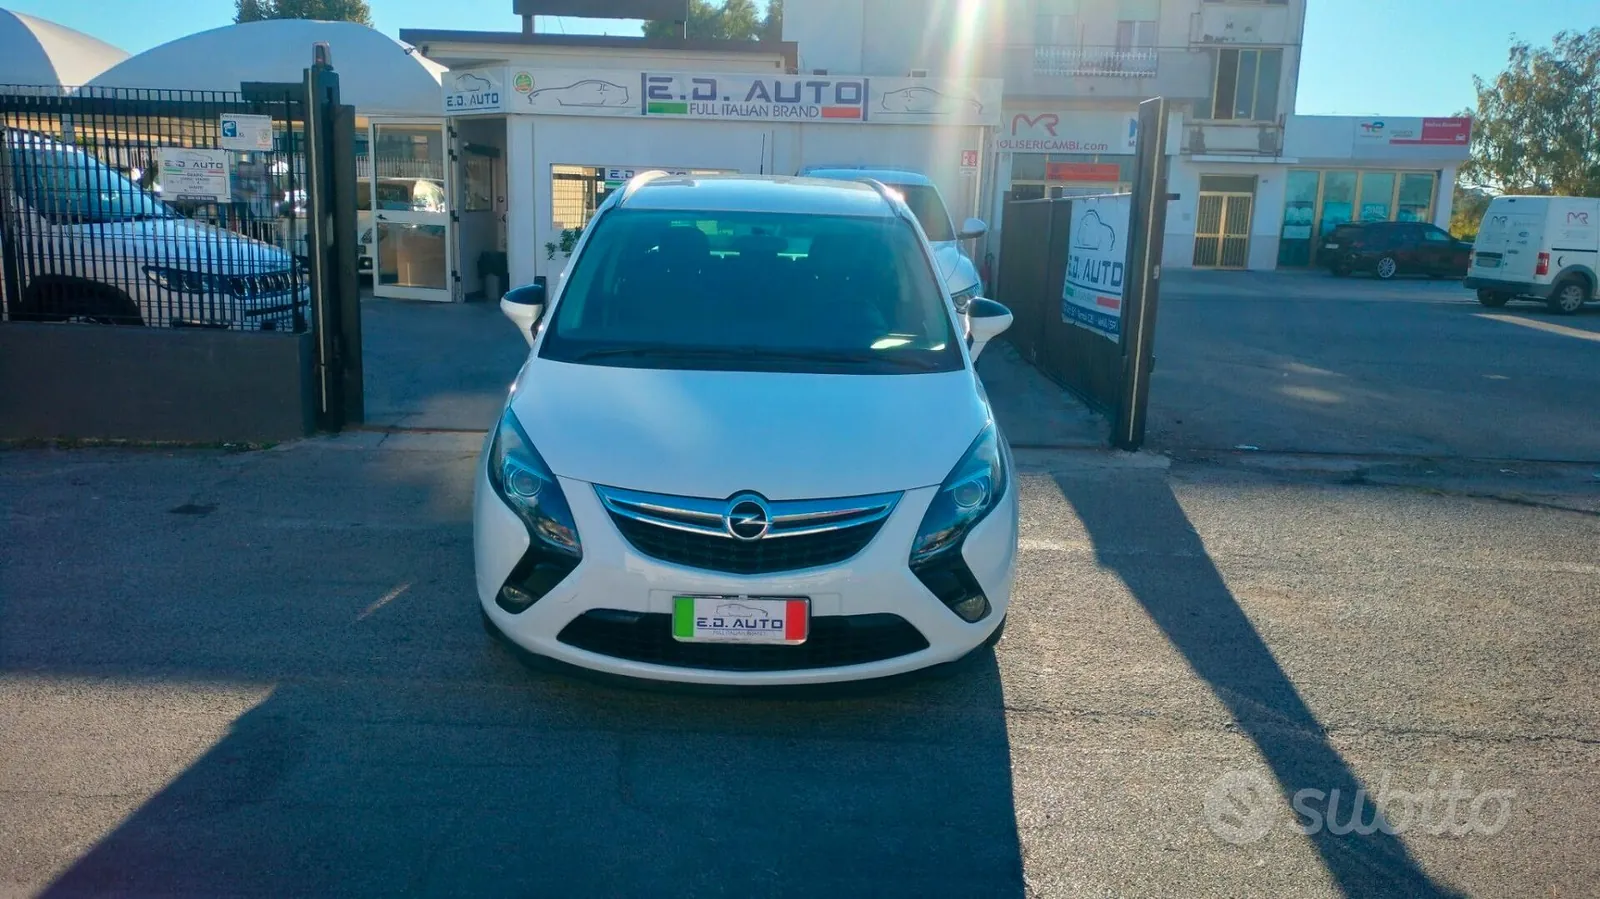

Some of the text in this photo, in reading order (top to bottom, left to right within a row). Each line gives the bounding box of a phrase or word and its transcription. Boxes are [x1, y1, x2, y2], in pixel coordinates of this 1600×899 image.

[648, 76, 862, 105] E.D. AUTO
[446, 92, 499, 107] E.D. AUTO
[689, 102, 820, 118] FULL ITALIAN BRAND
[193, 161, 224, 169] AUTO
[1083, 258, 1124, 287] AUTO
[697, 617, 783, 629] E.D. AUTO
